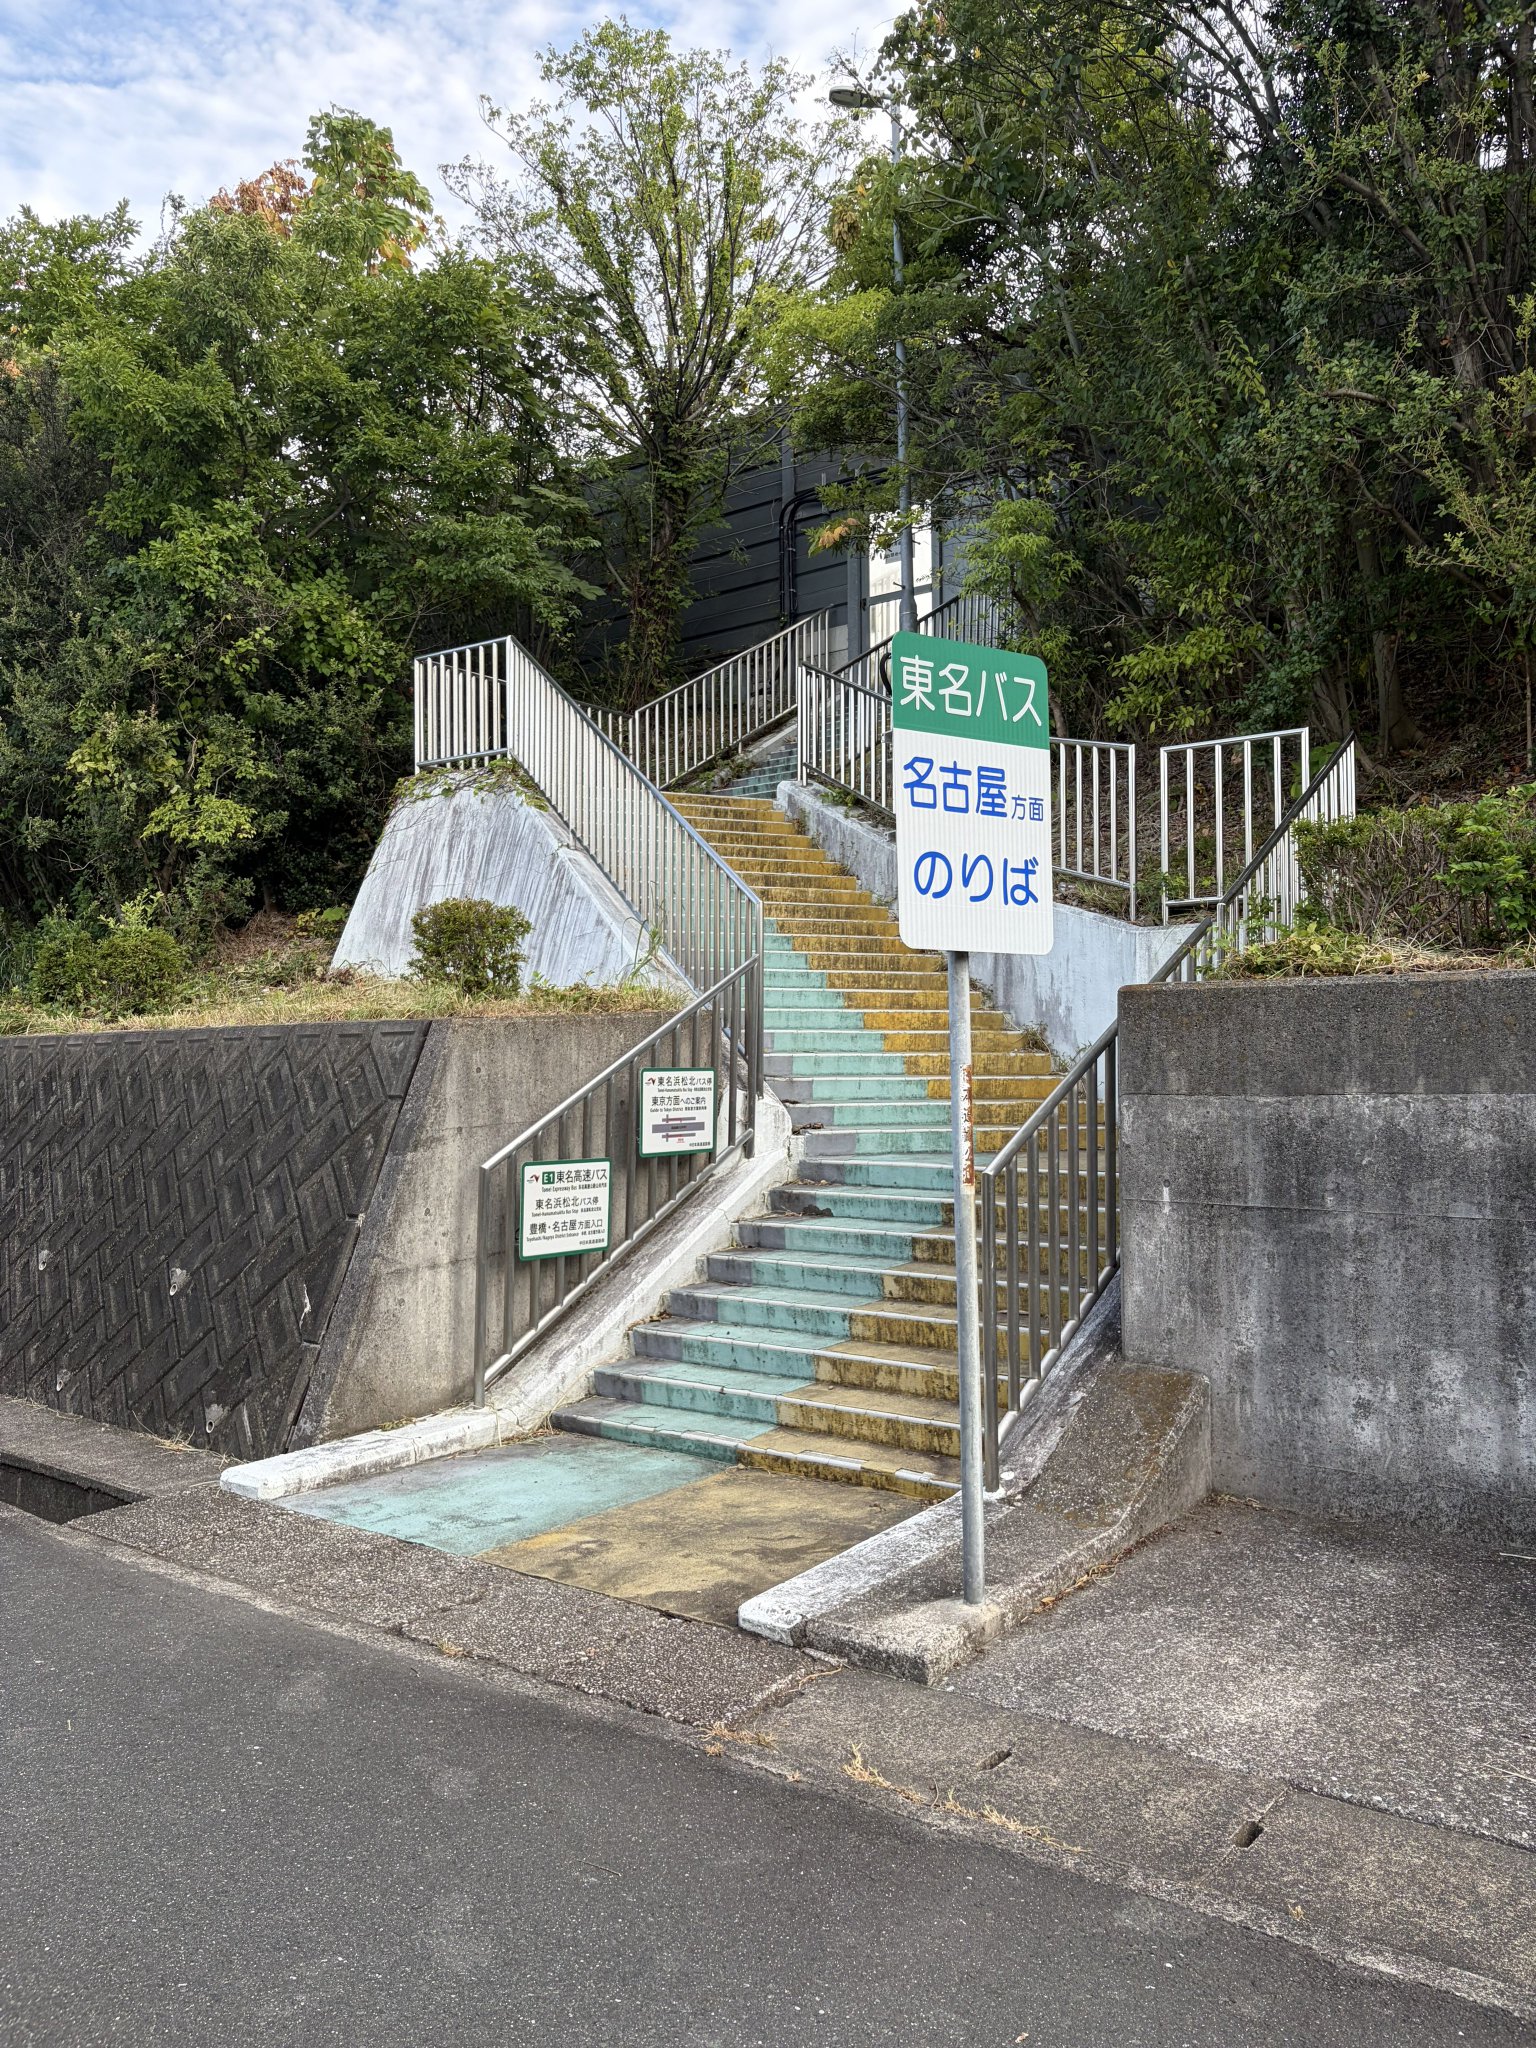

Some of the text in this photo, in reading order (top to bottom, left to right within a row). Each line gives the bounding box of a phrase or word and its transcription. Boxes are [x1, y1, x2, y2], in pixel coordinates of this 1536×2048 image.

[900, 654, 1042, 727] 東名バス
[903, 756, 1044, 822] 名古屋方面
[913, 851, 1039, 906] のりば
[657, 1075, 712, 1087] 東名浜松北バス停
[651, 1095, 706, 1106] 東京方面へのご案内
[543, 1172, 554, 1183] E1
[556, 1168, 607, 1184] 東名高速バス
[535, 1195, 599, 1211] 東名浜松北バス停
[529, 1219, 603, 1235] 豊橋・名古屋方面入口
